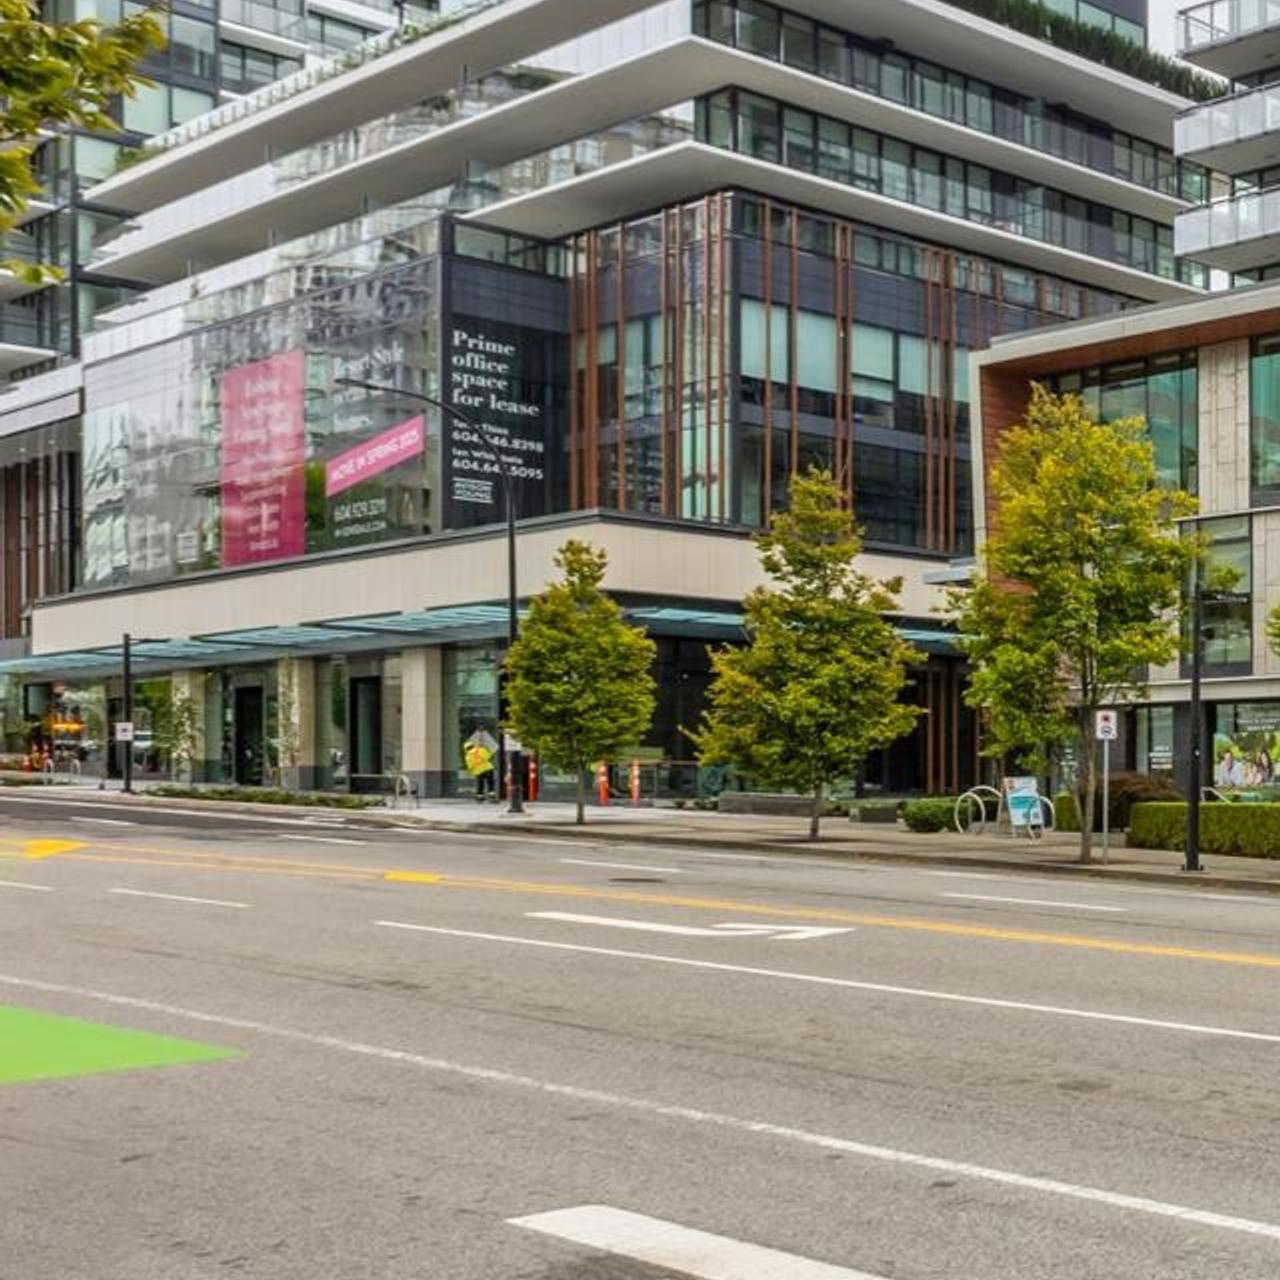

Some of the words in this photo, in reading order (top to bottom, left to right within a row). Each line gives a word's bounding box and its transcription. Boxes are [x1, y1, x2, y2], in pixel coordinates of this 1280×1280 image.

[452, 330, 516, 357] Prime
[452, 352, 510, 375] office
[452, 372, 509, 391] space
[452, 388, 485, 408] for
[490, 394, 540, 418] lease
[452, 459, 544, 480] 604.64.5095
